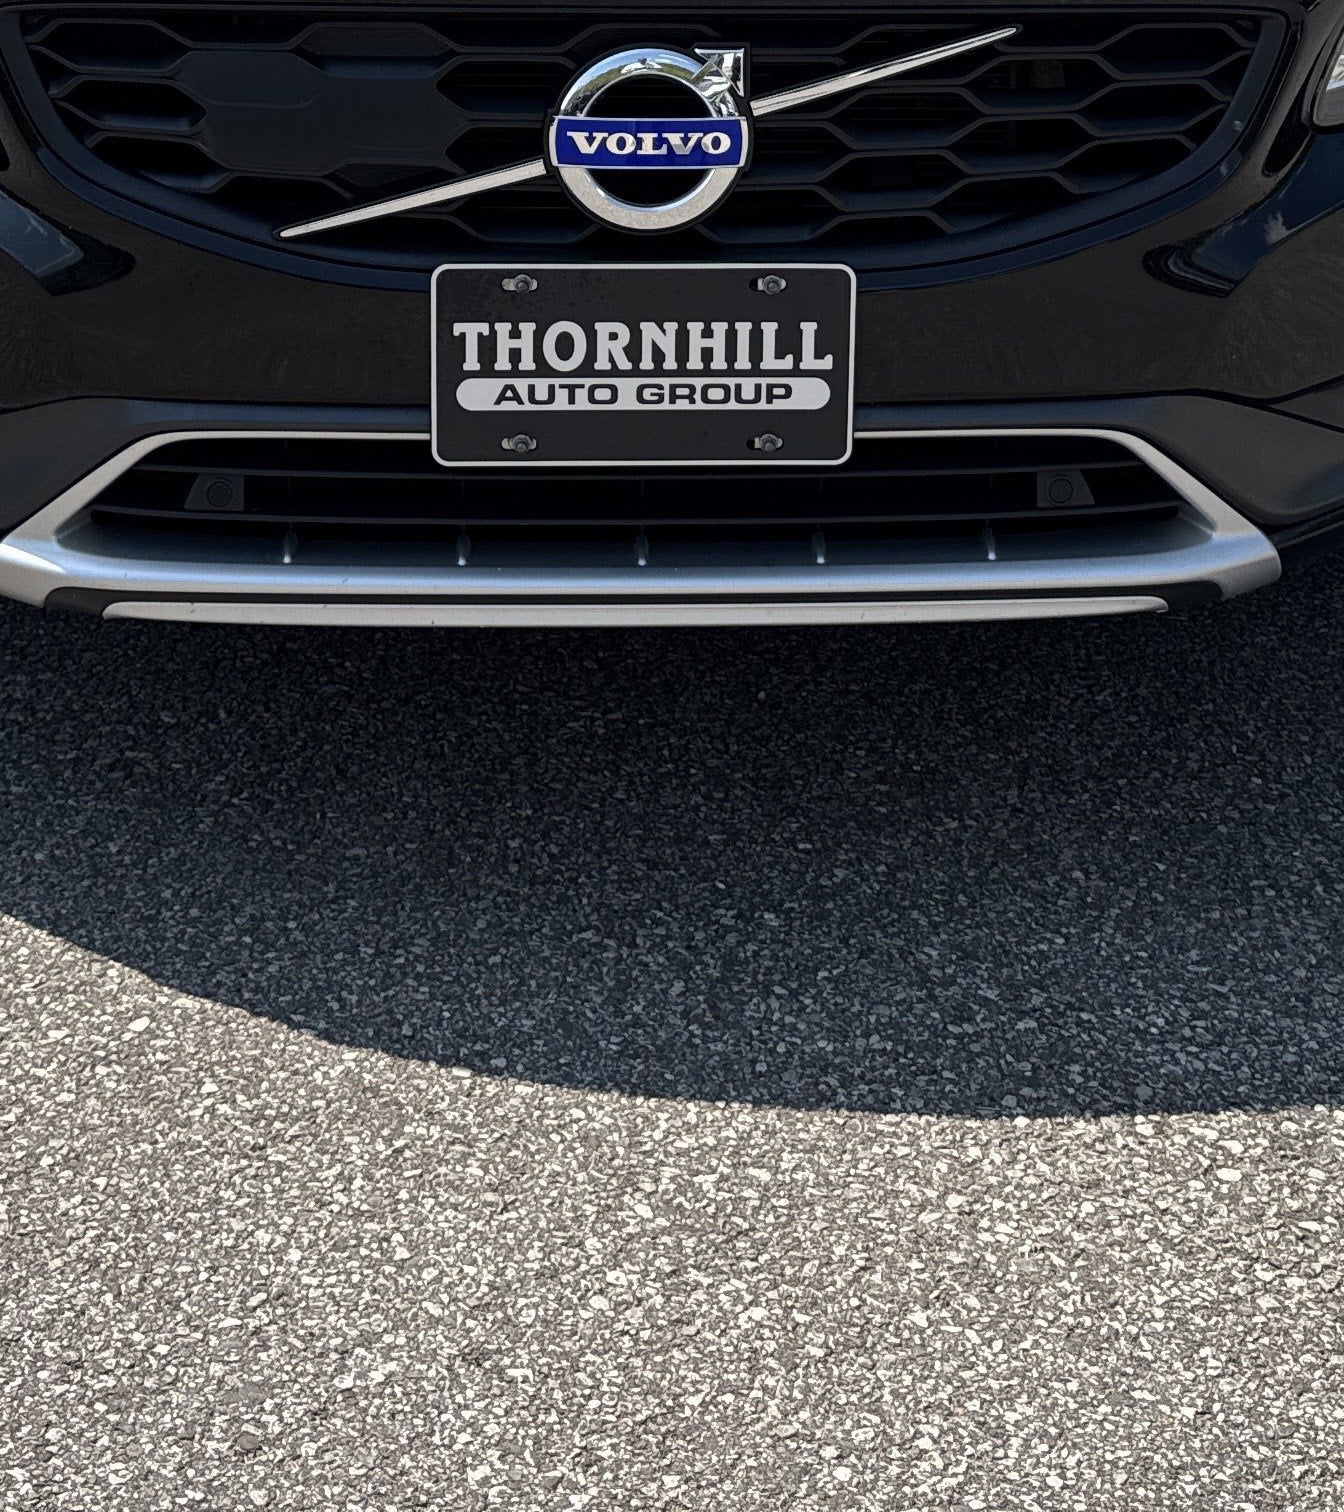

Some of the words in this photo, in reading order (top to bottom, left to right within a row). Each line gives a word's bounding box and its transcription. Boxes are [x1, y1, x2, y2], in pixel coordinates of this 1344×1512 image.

[566, 131, 731, 155] VOLVO
[452, 320, 834, 372] THORNHILL
[493, 383, 619, 406] AUTO
[635, 382, 793, 406] GROUP
